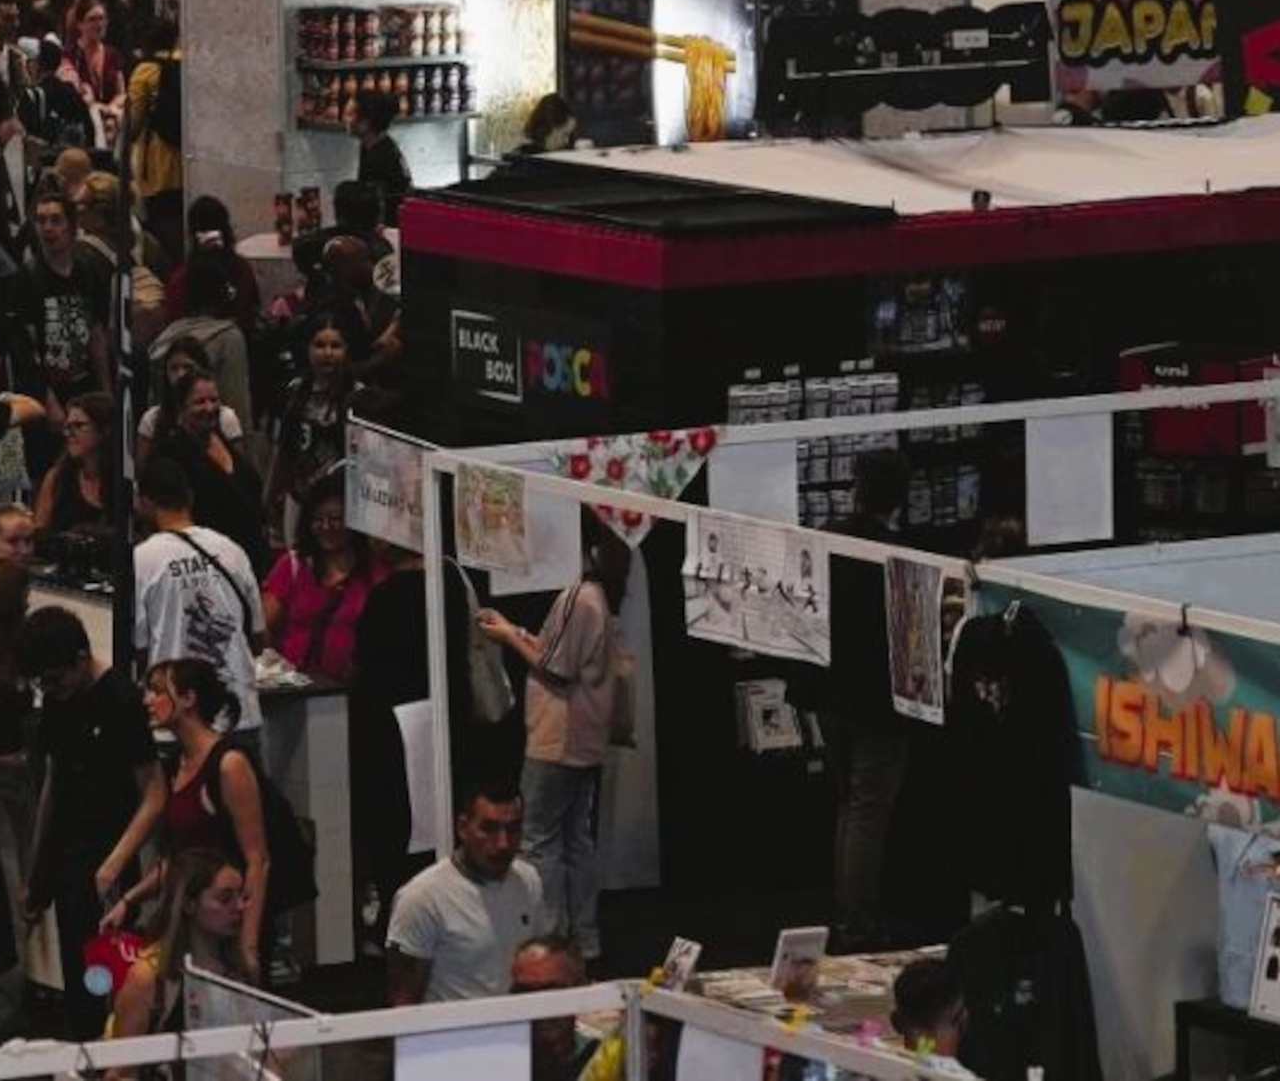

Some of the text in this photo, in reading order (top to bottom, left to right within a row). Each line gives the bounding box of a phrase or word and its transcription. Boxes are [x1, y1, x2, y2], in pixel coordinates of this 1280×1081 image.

[458, 328, 500, 354] BLACK
[484, 360, 516, 386] BOX
[525, 338, 610, 400] POSCA
